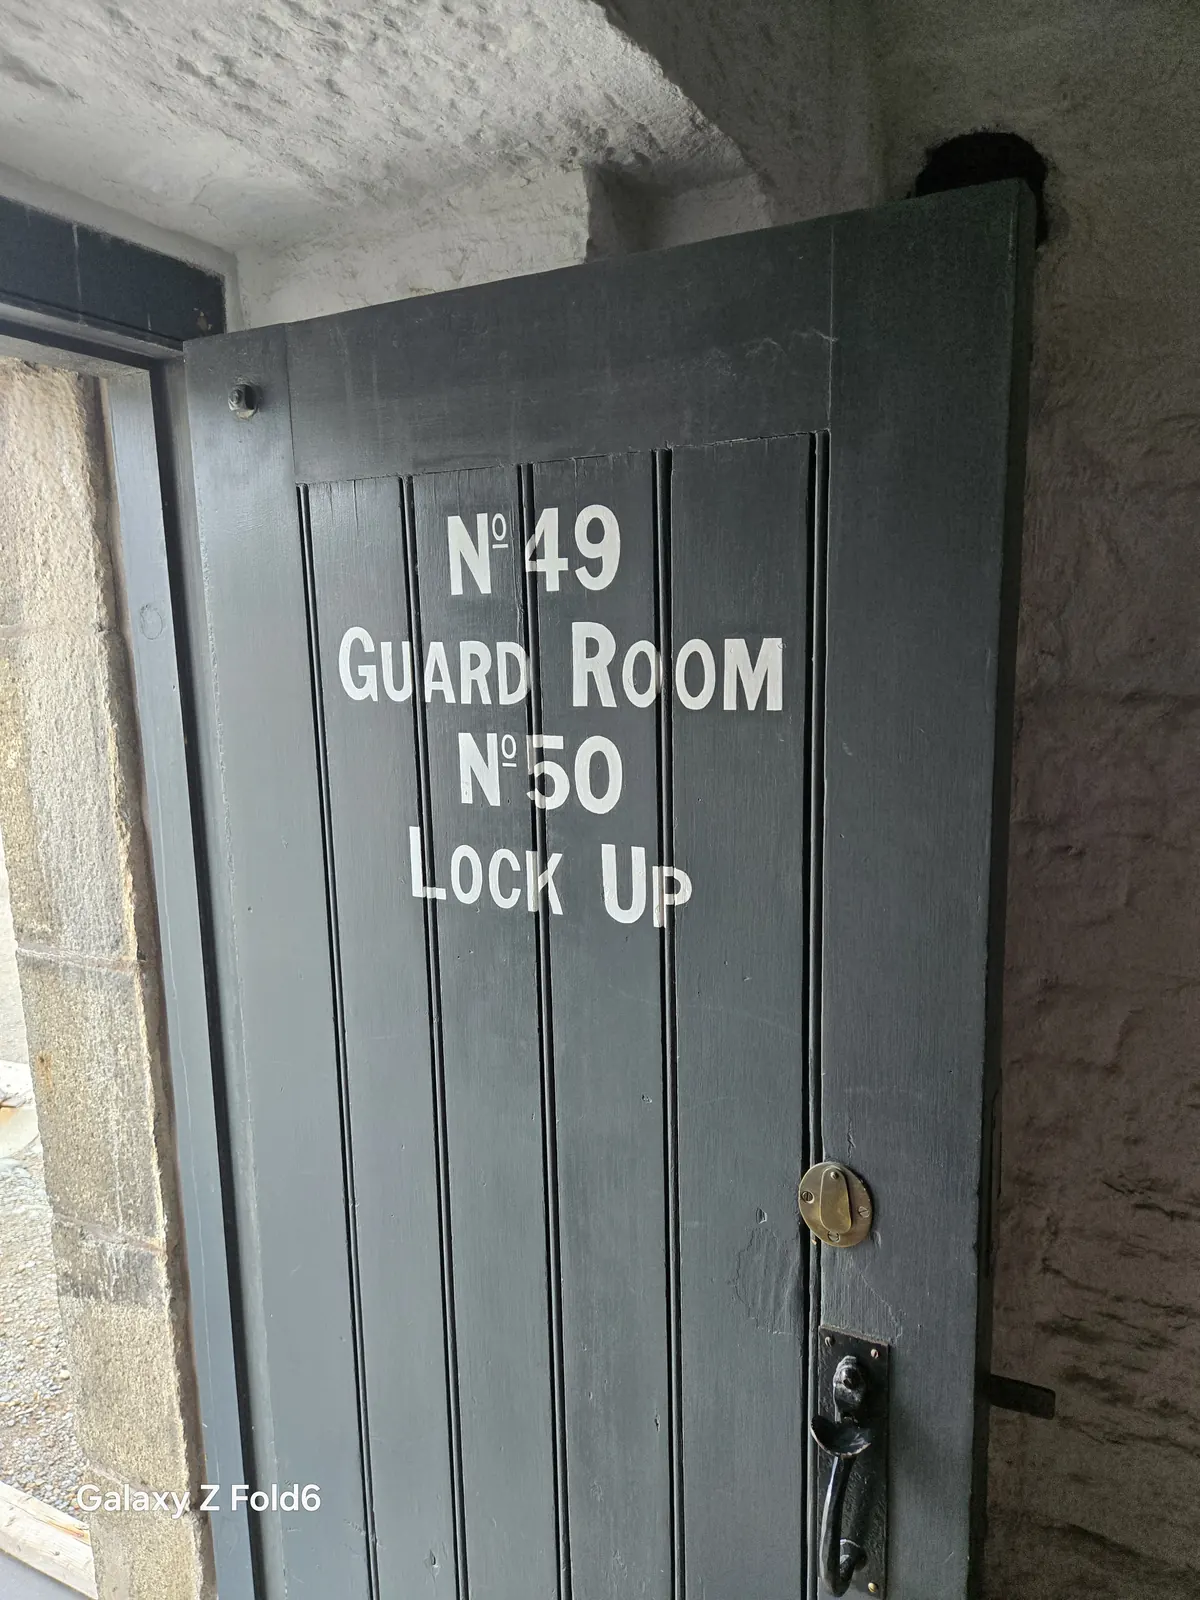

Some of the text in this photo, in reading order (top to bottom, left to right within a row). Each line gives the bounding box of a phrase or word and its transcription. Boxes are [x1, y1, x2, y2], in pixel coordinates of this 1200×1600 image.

[524, 503, 621, 592] 49
[338, 621, 784, 711] GUARD ROOM
[525, 734, 623, 815] 50
[408, 826, 693, 929] LOCK UP
